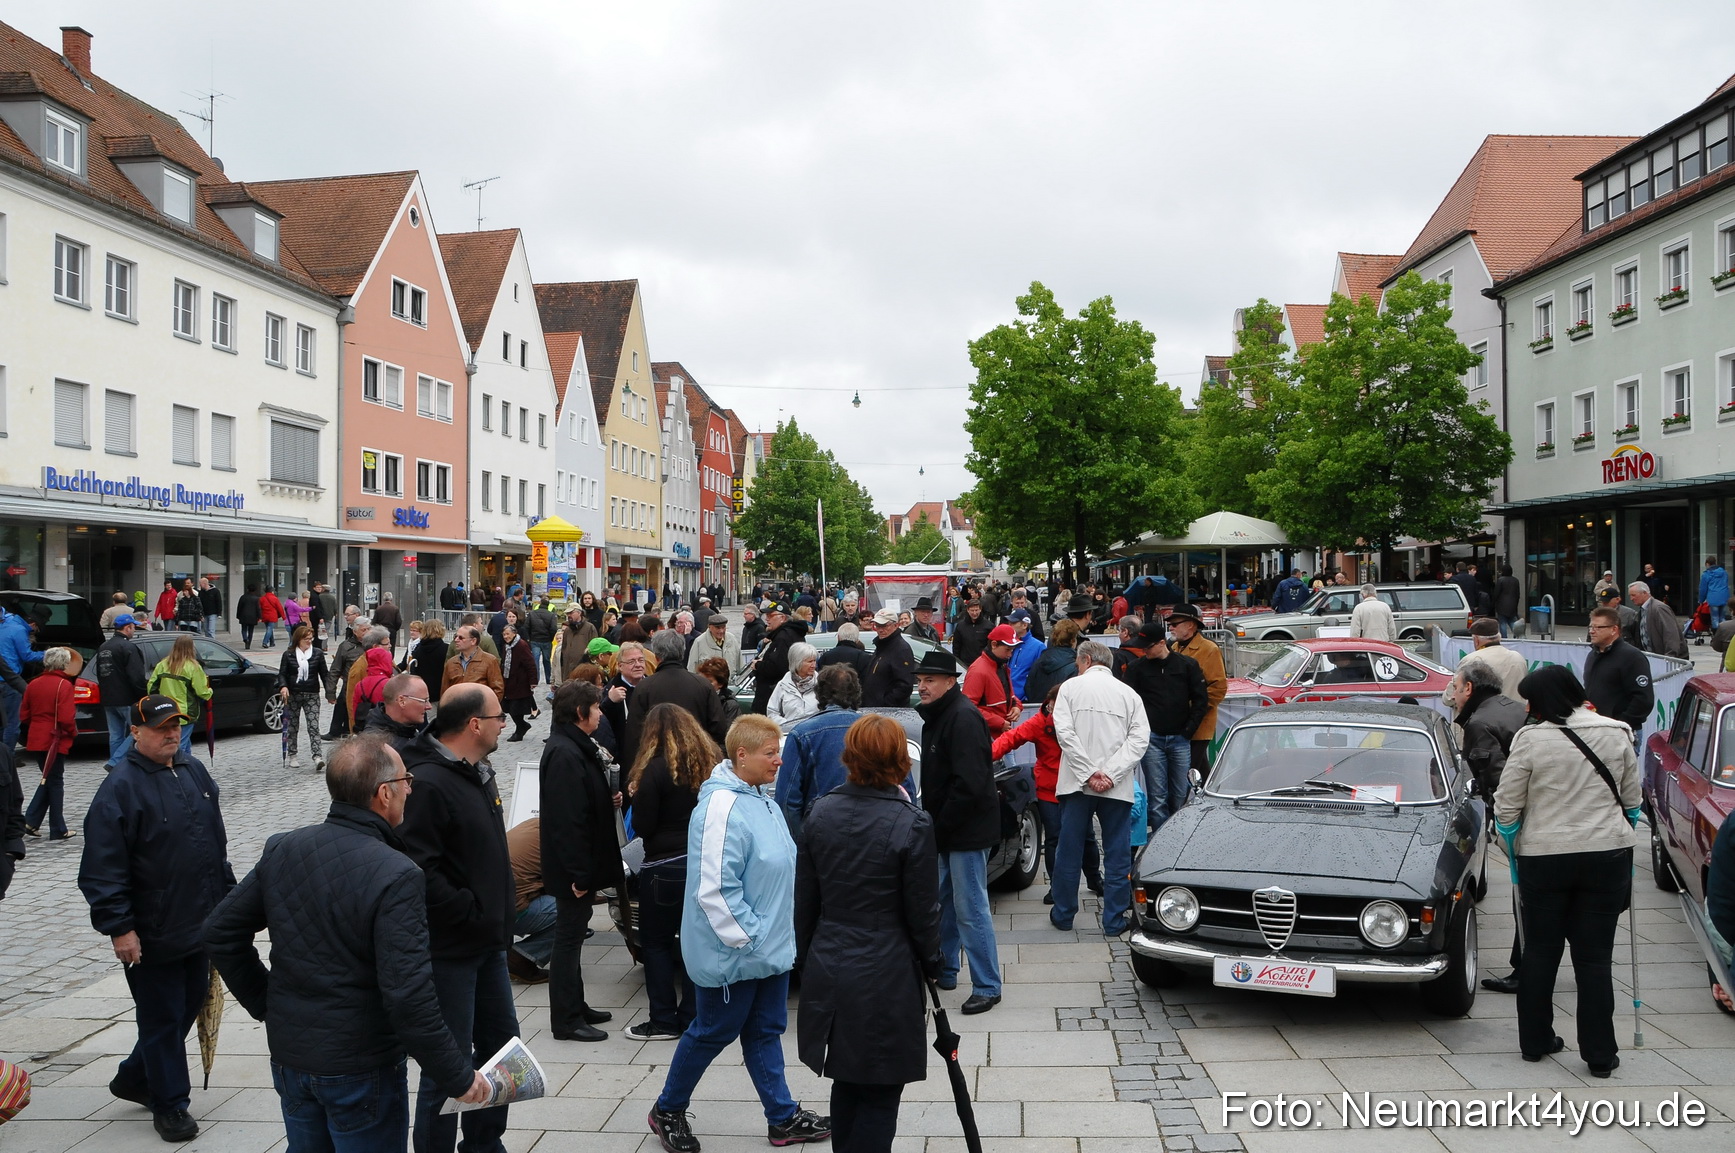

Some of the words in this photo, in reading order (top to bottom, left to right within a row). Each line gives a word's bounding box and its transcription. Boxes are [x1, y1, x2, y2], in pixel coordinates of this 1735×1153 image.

[1601, 452, 1655, 484] RENO
[44, 466, 171, 507] Buchhandlung
[175, 483, 245, 510] Rupprecht
[1382, 662, 1392, 675] 12
[1278, 966, 1308, 974] AUTO
[1253, 979, 1303, 988] BREITENBRUNN
